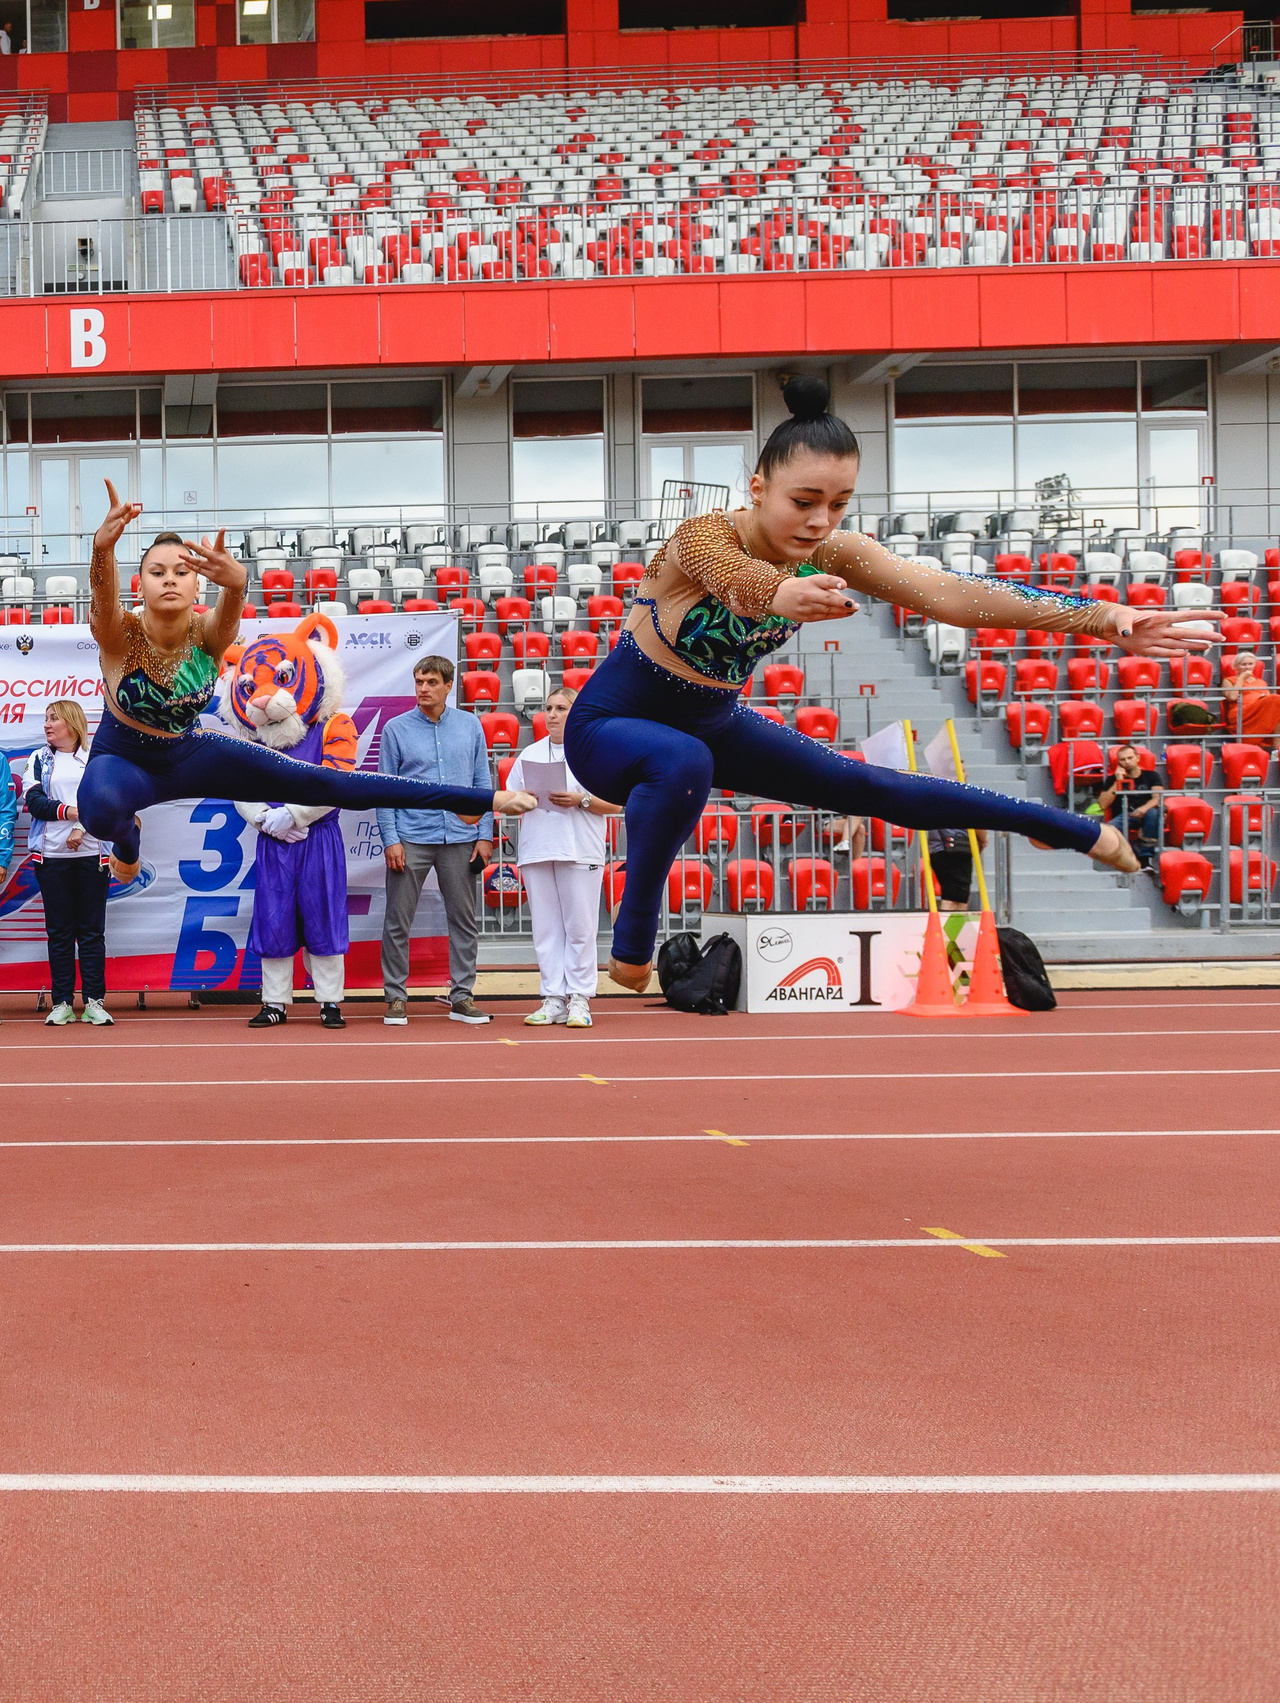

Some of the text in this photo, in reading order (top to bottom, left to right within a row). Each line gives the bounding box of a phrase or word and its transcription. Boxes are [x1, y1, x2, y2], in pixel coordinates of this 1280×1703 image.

[70, 308, 107, 368] В
[345, 633, 391, 645] АССК
[765, 987, 844, 1001] АВАНГАРД
